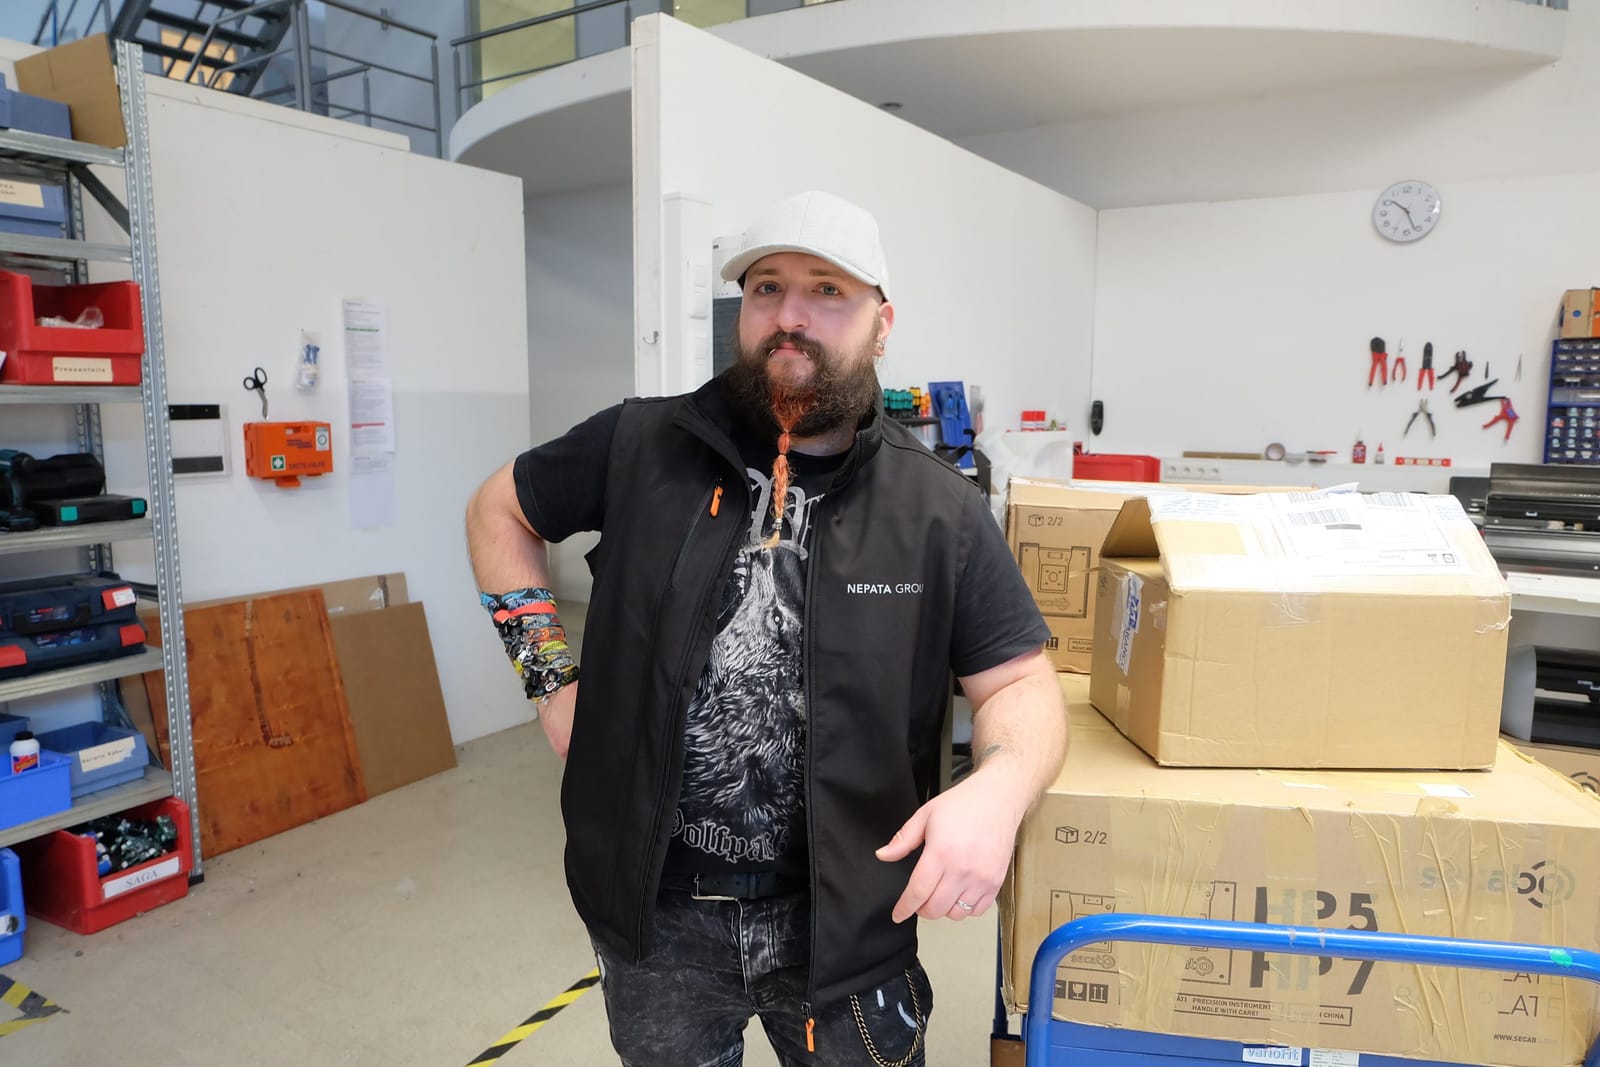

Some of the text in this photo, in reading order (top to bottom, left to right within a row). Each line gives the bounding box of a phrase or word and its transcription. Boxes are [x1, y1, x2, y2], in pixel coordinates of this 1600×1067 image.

[1047, 516, 1064, 527] 2/2
[847, 583, 893, 594] NEPATA
[1083, 829, 1108, 845] 2/2
[125, 869, 158, 888] SAGA
[1254, 886, 1379, 932] HP5
[1193, 998, 1228, 1007] PRECISION
[1192, 1005, 1219, 1014] HANDLE
[1238, 1009, 1259, 1017] CARE!
[1323, 1012, 1345, 1020] CHINA
